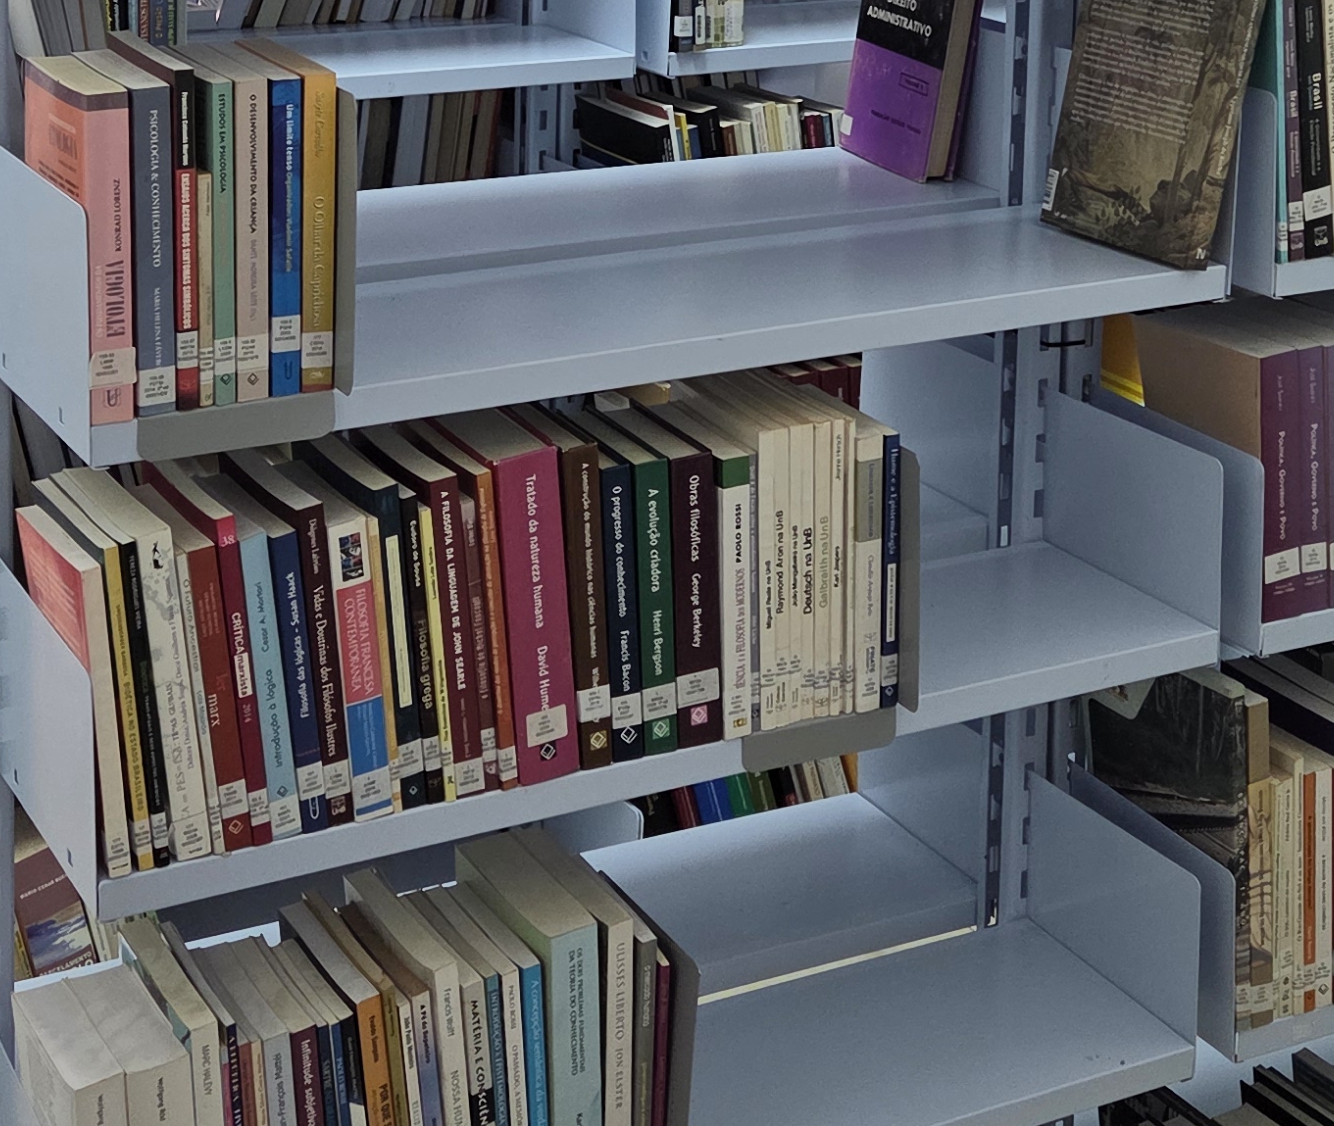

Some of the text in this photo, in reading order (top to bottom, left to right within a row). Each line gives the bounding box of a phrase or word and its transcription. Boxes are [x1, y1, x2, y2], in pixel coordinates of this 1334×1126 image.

[866, 5, 933, 38] ADMINISTRATIVO
[1311, 72, 1324, 110] Brasil
[217, 93, 227, 194] ESTUDOS EM PSICOLOGIA
[104, 259, 126, 338] ETOLOGIA
[525, 473, 544, 629] Tratado da natureza humana
[688, 474, 701, 563] Obras filosóficas
[775, 510, 785, 615] Raymond Aron na UnB
[691, 572, 703, 649] George Berkeley
[802, 527, 813, 615] Deutsch na UnB
[343, 597, 361, 693] CONTEMPORÂNEA
[355, 587, 375, 695] FILOSOFIA FRANCESA
[208, 693, 221, 727] marx
[300, 1038, 313, 1085] Infinitude
[614, 942, 625, 1111] ULISSES LIBERTO JON ELSTER
[450, 1070, 462, 1099] NOSSA
